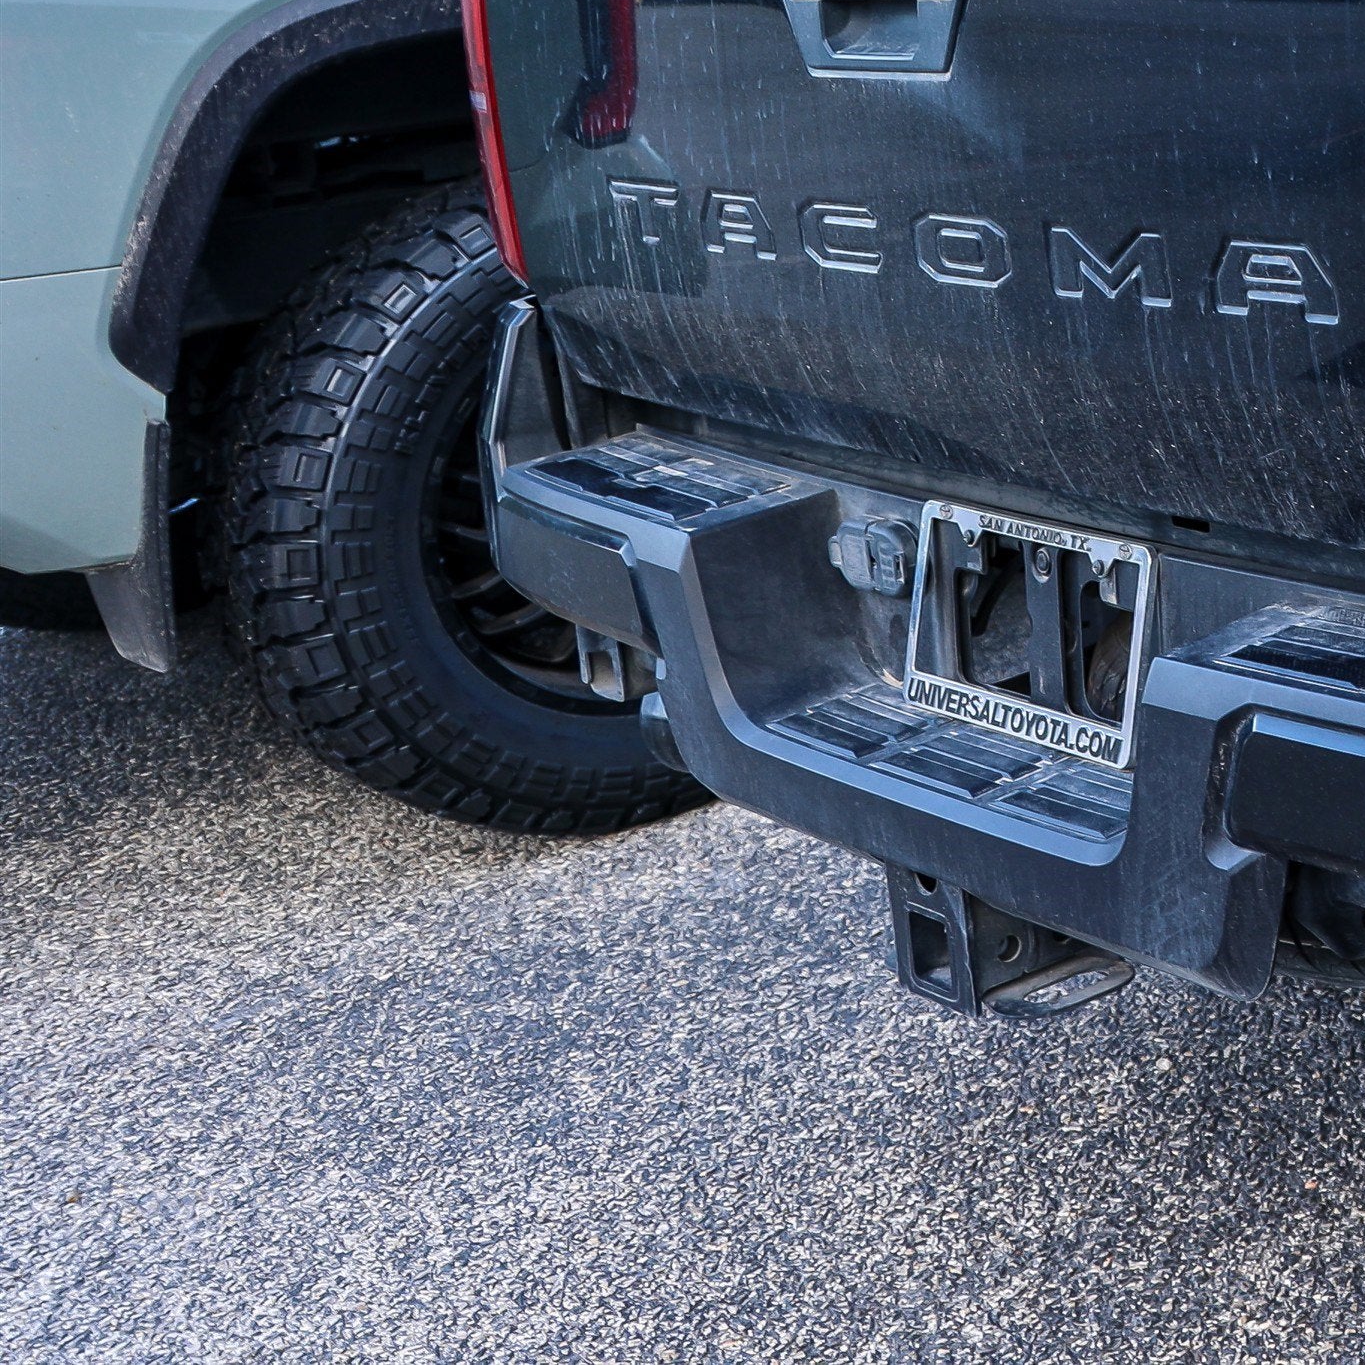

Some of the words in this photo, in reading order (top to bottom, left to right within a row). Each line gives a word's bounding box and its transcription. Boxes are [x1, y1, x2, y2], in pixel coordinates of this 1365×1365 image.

[608, 181, 1339, 324] TACOMA
[979, 515, 1003, 531] SAN
[907, 677, 1123, 764] UNIVERSALTOYOTA.COM
